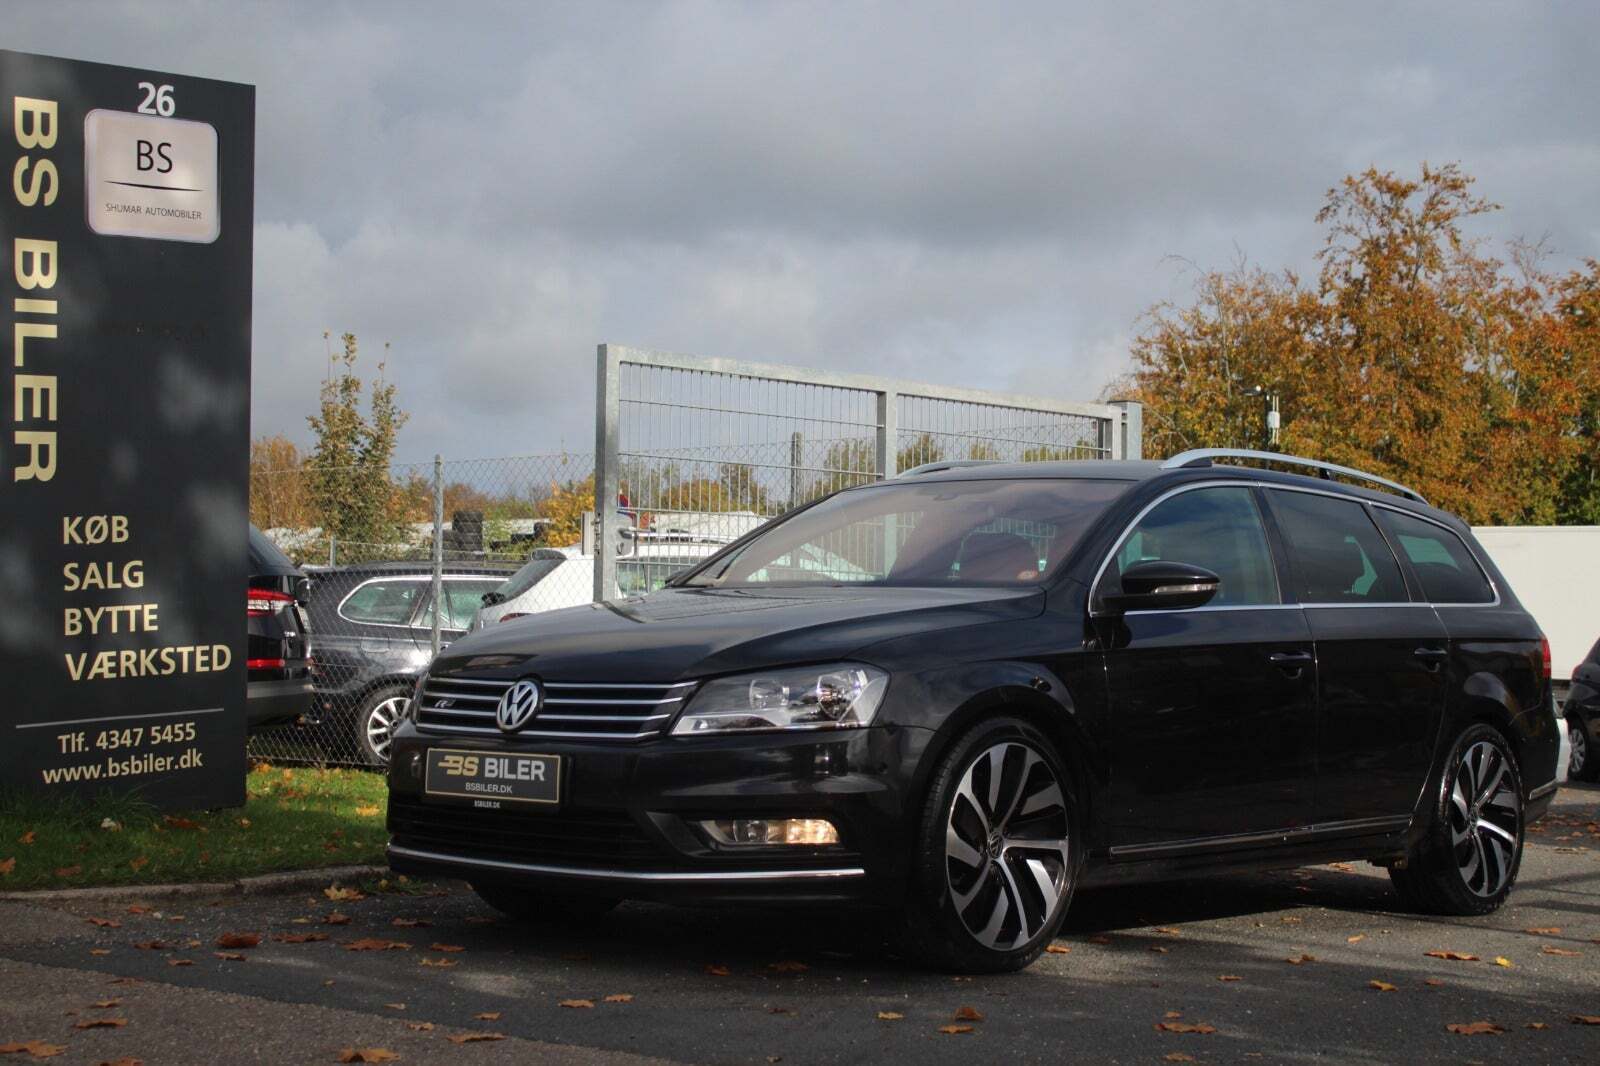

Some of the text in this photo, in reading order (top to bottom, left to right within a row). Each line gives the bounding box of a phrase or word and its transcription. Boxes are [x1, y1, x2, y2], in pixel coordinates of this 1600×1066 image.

[137, 82, 176, 117] 26
[136, 140, 173, 173] BS
[106, 203, 202, 220] SHUMAR AUTOMOBILER
[13, 96, 59, 482] BS BILER
[63, 515, 129, 545] KØB
[63, 560, 144, 592] SALG
[64, 604, 158, 636] BYTTE
[65, 644, 231, 680] VÆRKSTED
[57, 722, 196, 754] Tlf. 4347 5455
[42, 748, 203, 785] www.bsbiler.dk
[438, 755, 545, 782] BS BILER
[465, 782, 513, 794] BSBILER.DK
